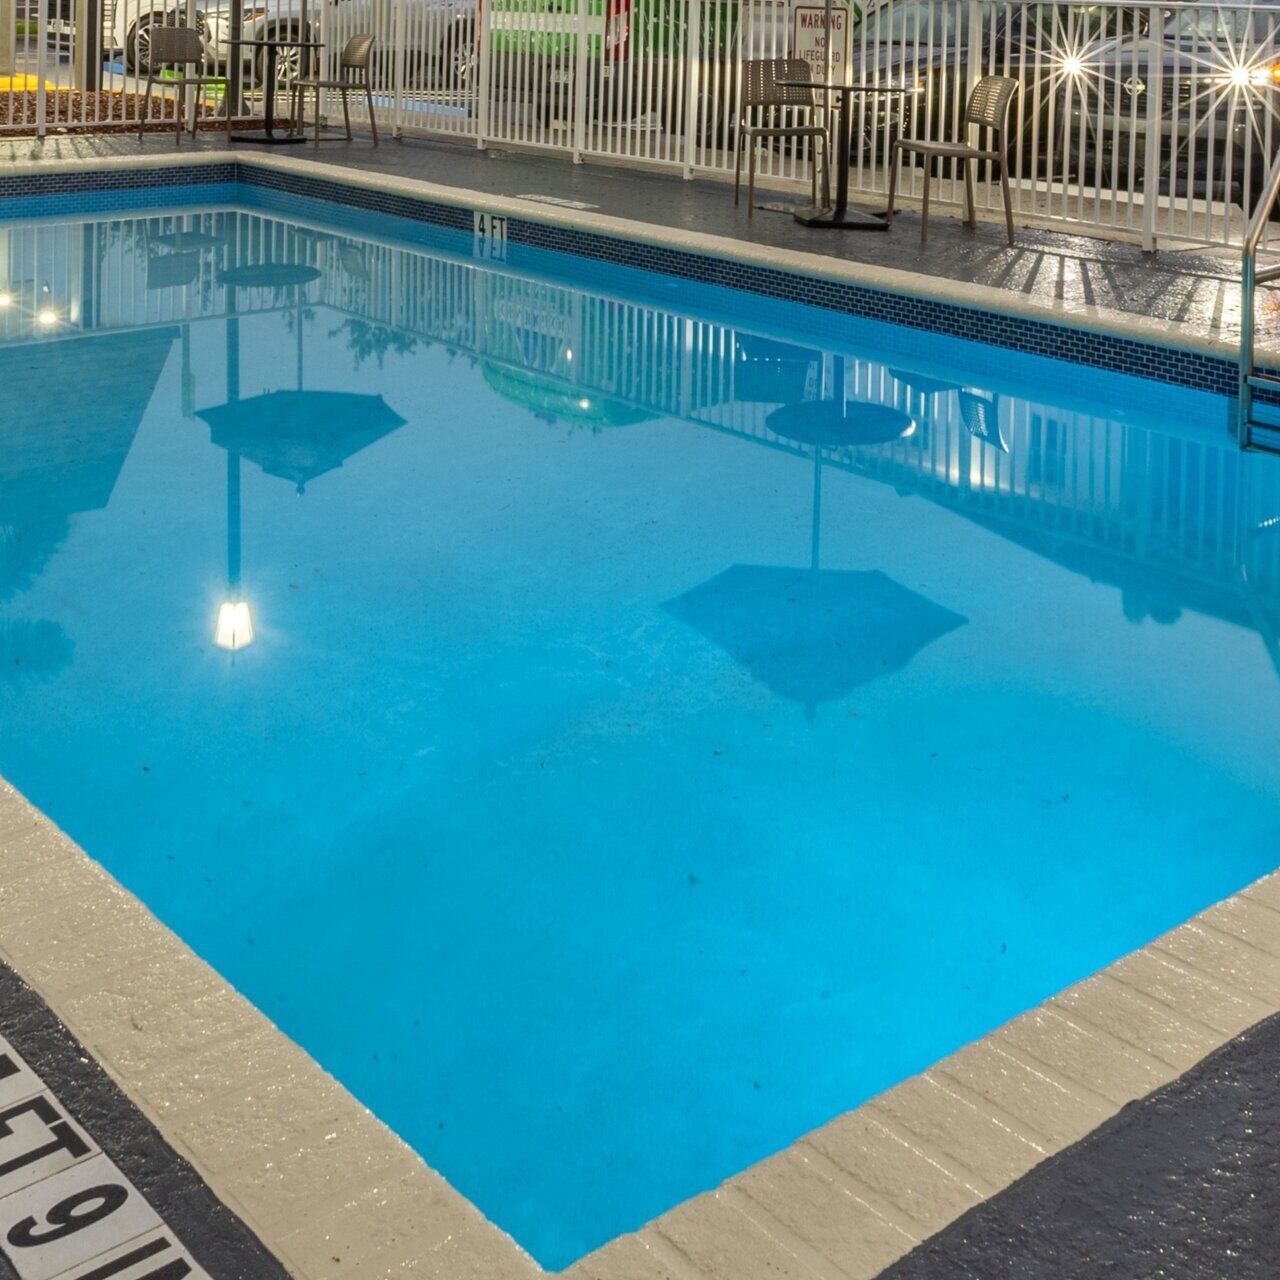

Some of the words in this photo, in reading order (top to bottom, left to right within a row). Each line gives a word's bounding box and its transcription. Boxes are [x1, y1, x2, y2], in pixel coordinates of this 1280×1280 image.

[800, 13, 842, 30] WARNNG
[799, 49, 841, 63] LIFEGURD
[816, 64, 836, 76] DUY
[478, 214, 486, 236] 4
[491, 216, 505, 240] FT
[6, 1183, 129, 1248] 9
